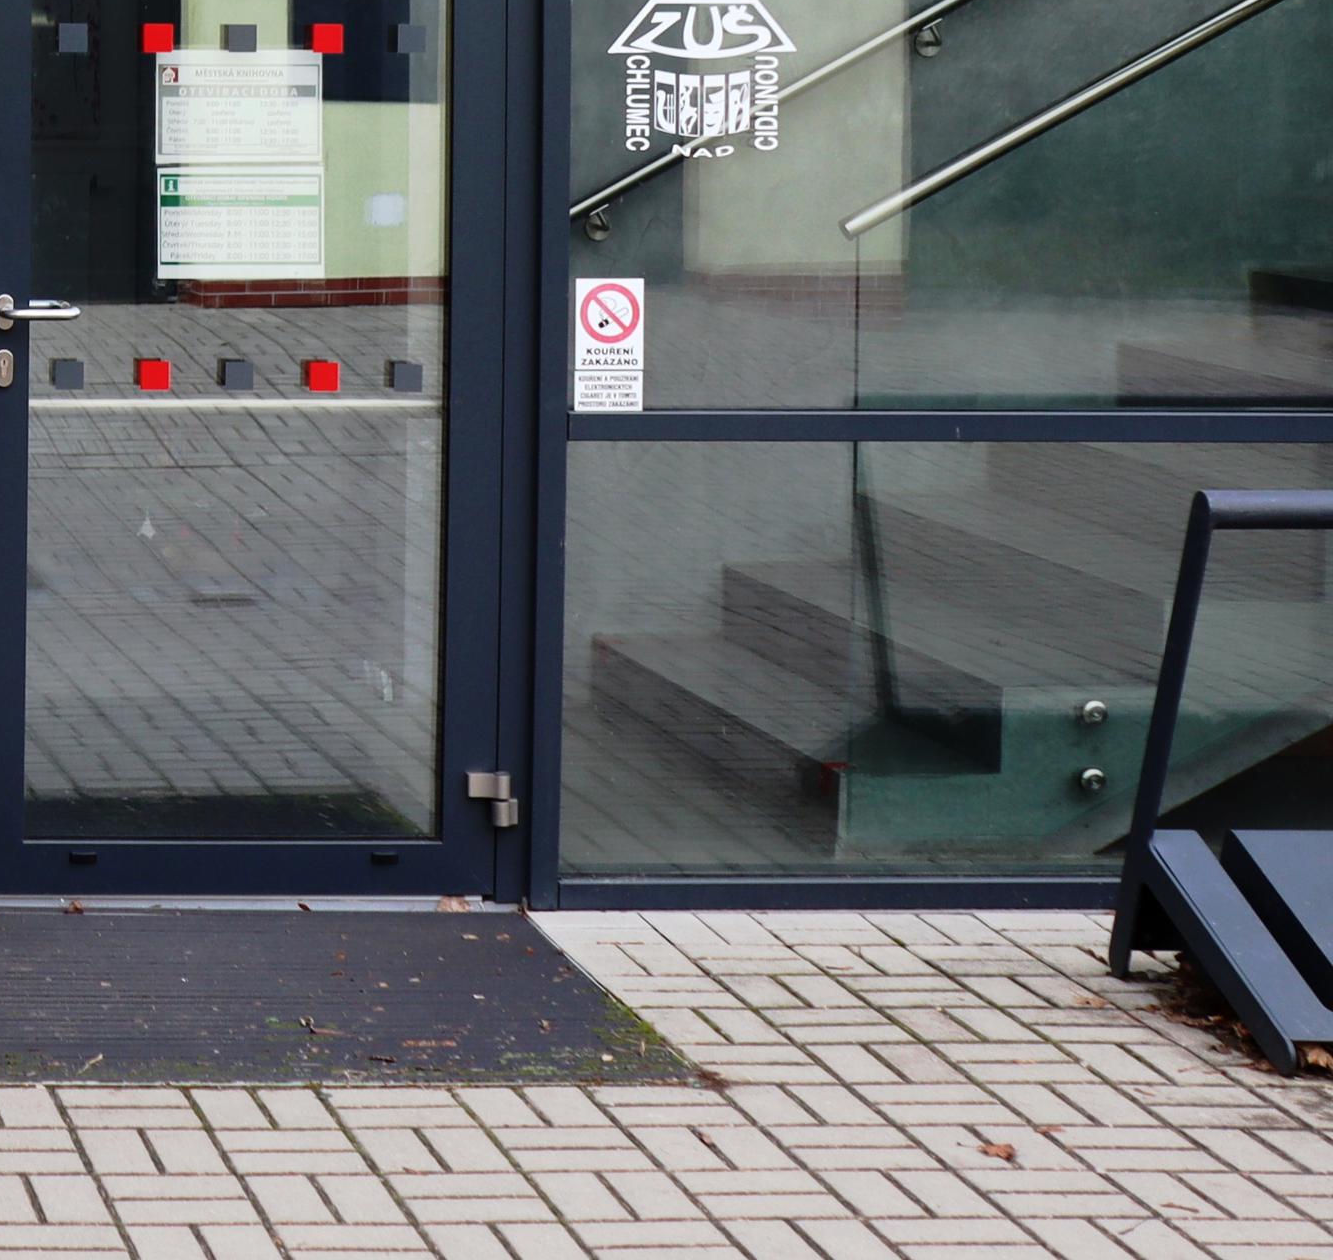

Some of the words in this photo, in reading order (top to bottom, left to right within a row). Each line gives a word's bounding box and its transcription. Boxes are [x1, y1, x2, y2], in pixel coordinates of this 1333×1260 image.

[630, 5, 772, 59] ZUŠ
[195, 66, 235, 78] MĚSTSKÁ
[236, 67, 284, 78] KNIHOVNA
[259, 86, 299, 97] DOBA
[625, 55, 651, 152] CHLUMEC
[754, 55, 779, 151] CIDLINOU
[671, 143, 735, 158] NAD
[586, 345, 634, 356] KOUŘENÍ
[581, 357, 638, 366] ZAKÁZÁNO
